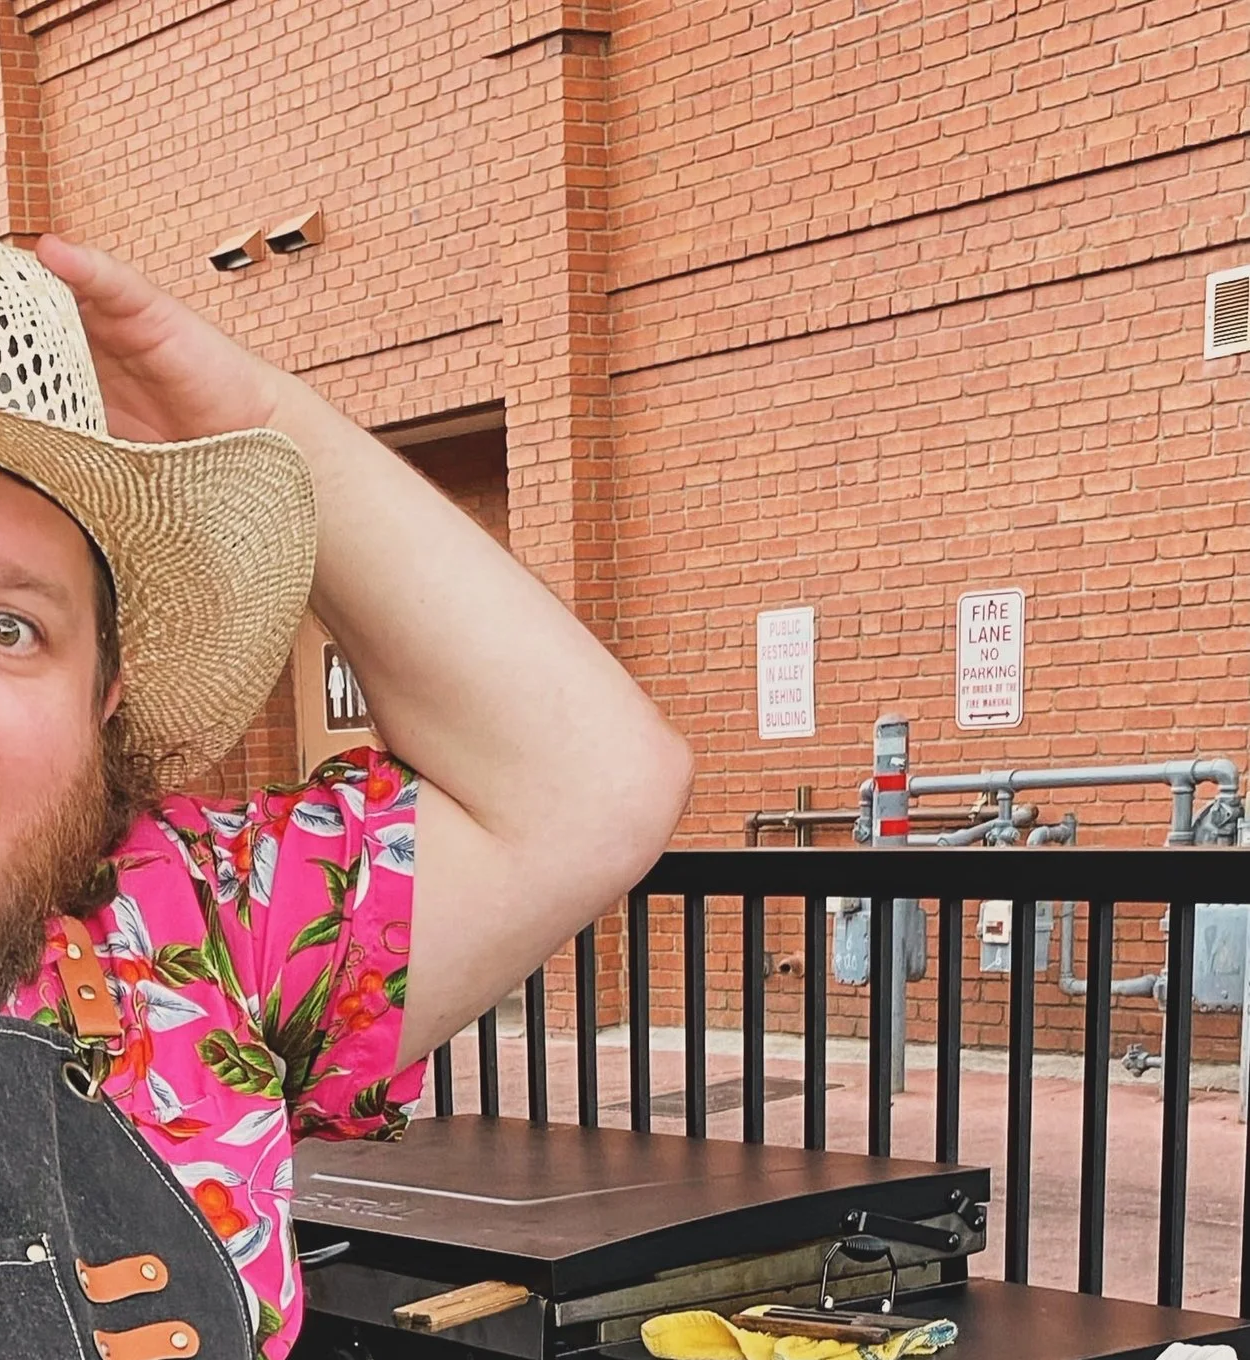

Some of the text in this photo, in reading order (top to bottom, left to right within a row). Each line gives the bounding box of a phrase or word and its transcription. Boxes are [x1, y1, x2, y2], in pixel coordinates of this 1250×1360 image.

[972, 602, 1009, 621] FIRE
[770, 620, 800, 637] PUBLIC
[969, 625, 1011, 643] LANE
[762, 642, 809, 660] RESTROOM
[980, 648, 999, 661] NO
[766, 664, 804, 682] IN ALLEY
[962, 665, 1017, 680] PARKING
[769, 688, 801, 704] BEHIND
[766, 710, 806, 727] BUILDING
